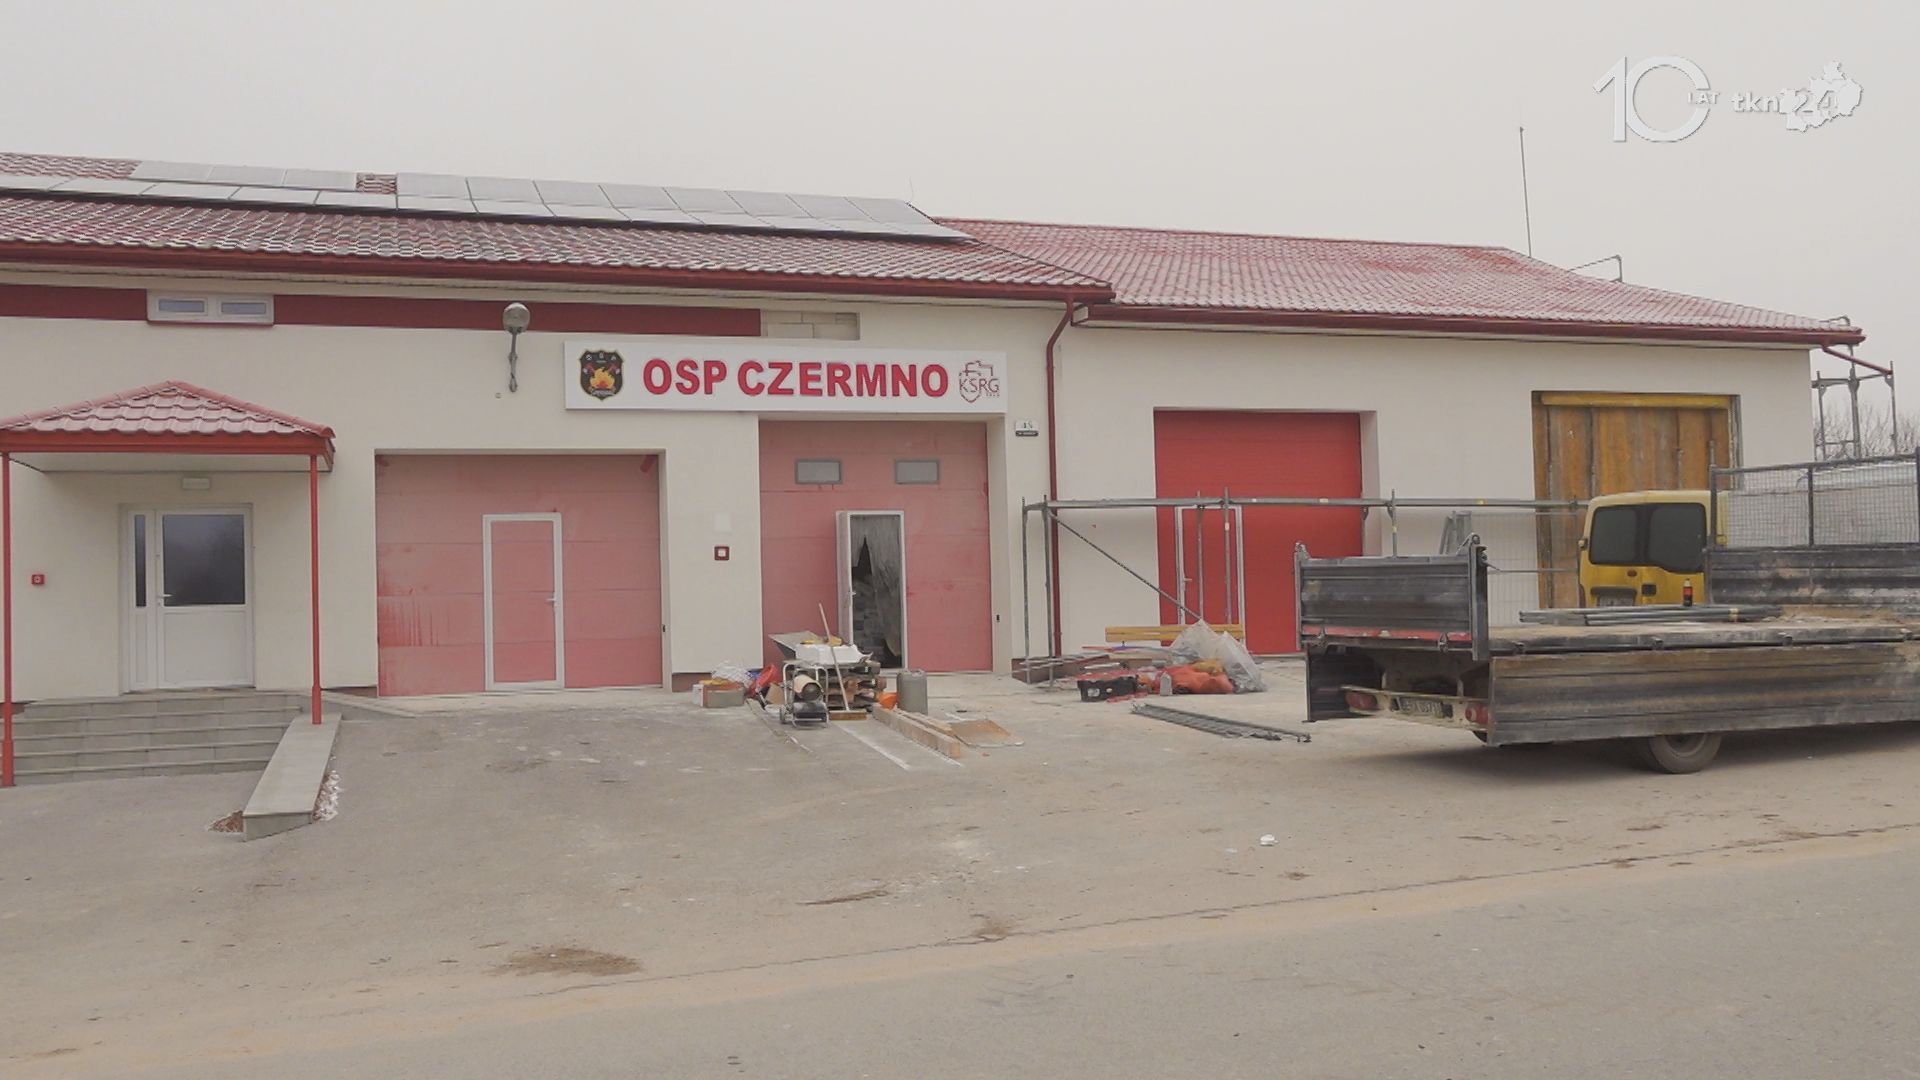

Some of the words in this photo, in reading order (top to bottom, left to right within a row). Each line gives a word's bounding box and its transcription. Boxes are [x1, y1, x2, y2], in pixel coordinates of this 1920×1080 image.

[643, 358, 728, 395] OSP
[737, 360, 949, 397] CZERMNO
[959, 377, 1000, 394] KSRG
